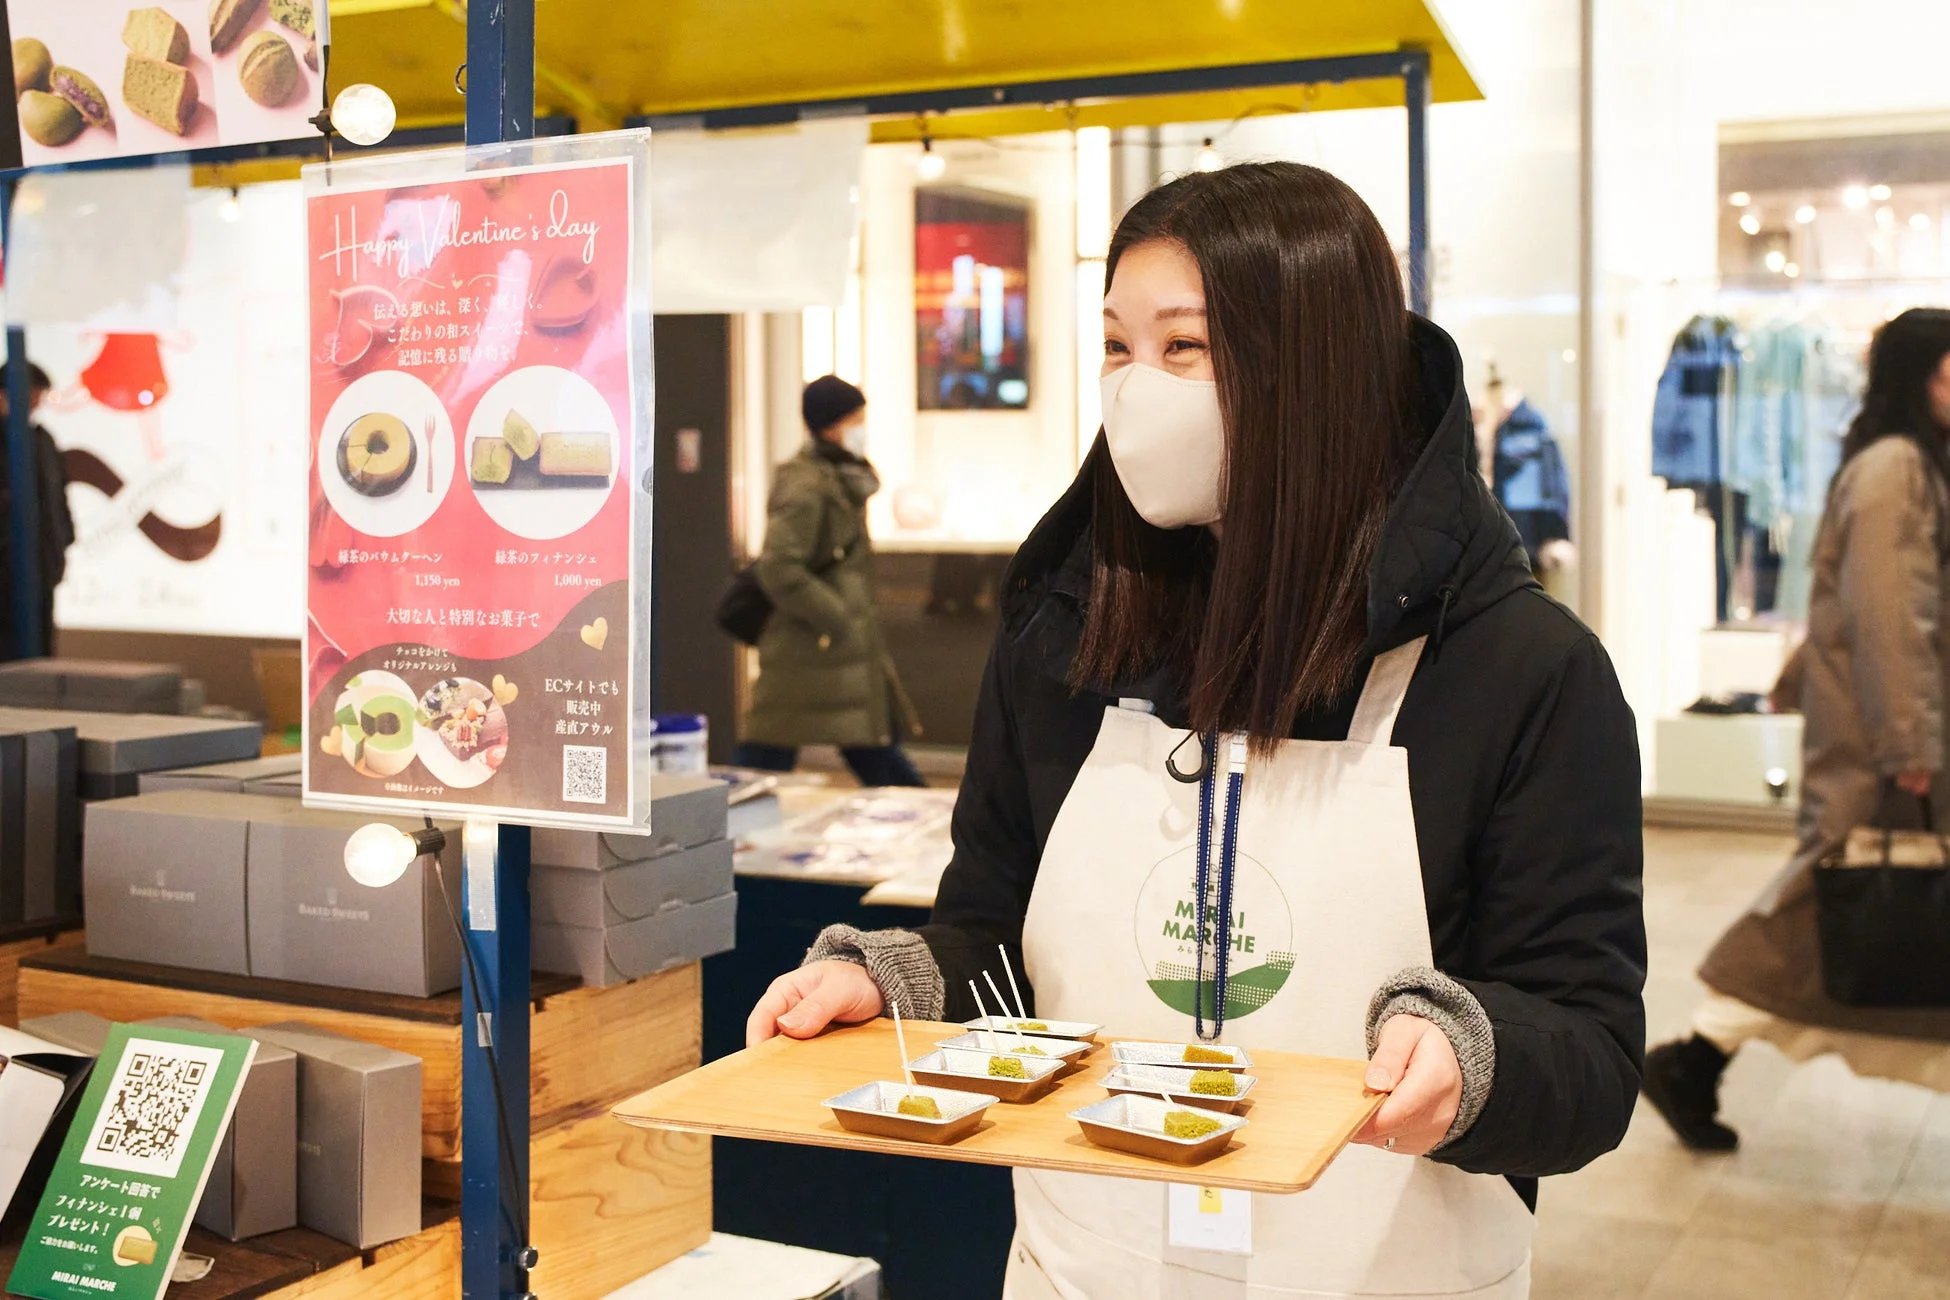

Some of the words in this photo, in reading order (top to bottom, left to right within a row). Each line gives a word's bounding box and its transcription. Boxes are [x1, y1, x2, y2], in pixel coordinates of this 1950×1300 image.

[319, 205, 412, 282] Happy
[417, 194, 542, 269] Valentine's
[546, 190, 601, 264] day
[338, 549, 443, 565] 緑茶のバウムクーヘン
[495, 549, 597, 565] 緑茶のフィナンシェ
[415, 574, 441, 587] 1,150
[443, 576, 460, 590] yen
[554, 574, 582, 588] 1,000
[584, 577, 602, 591] yen
[387, 608, 540, 628] 大切な人と特別なお菓子で
[395, 646, 449, 658] チョコをかけて
[383, 660, 457, 673] オリジナルアレンジも
[544, 678, 618, 696] ECサイトでも
[566, 699, 601, 716] 販売中
[555, 718, 613, 736] 産直アウル
[1175, 899, 1245, 929] MRI
[80, 1174, 161, 1199] アンケート回答で
[47, 1214, 110, 1236] プレゼント！
[51, 1270, 80, 1285] MIRAI
[79, 1275, 117, 1292] MARCHE
